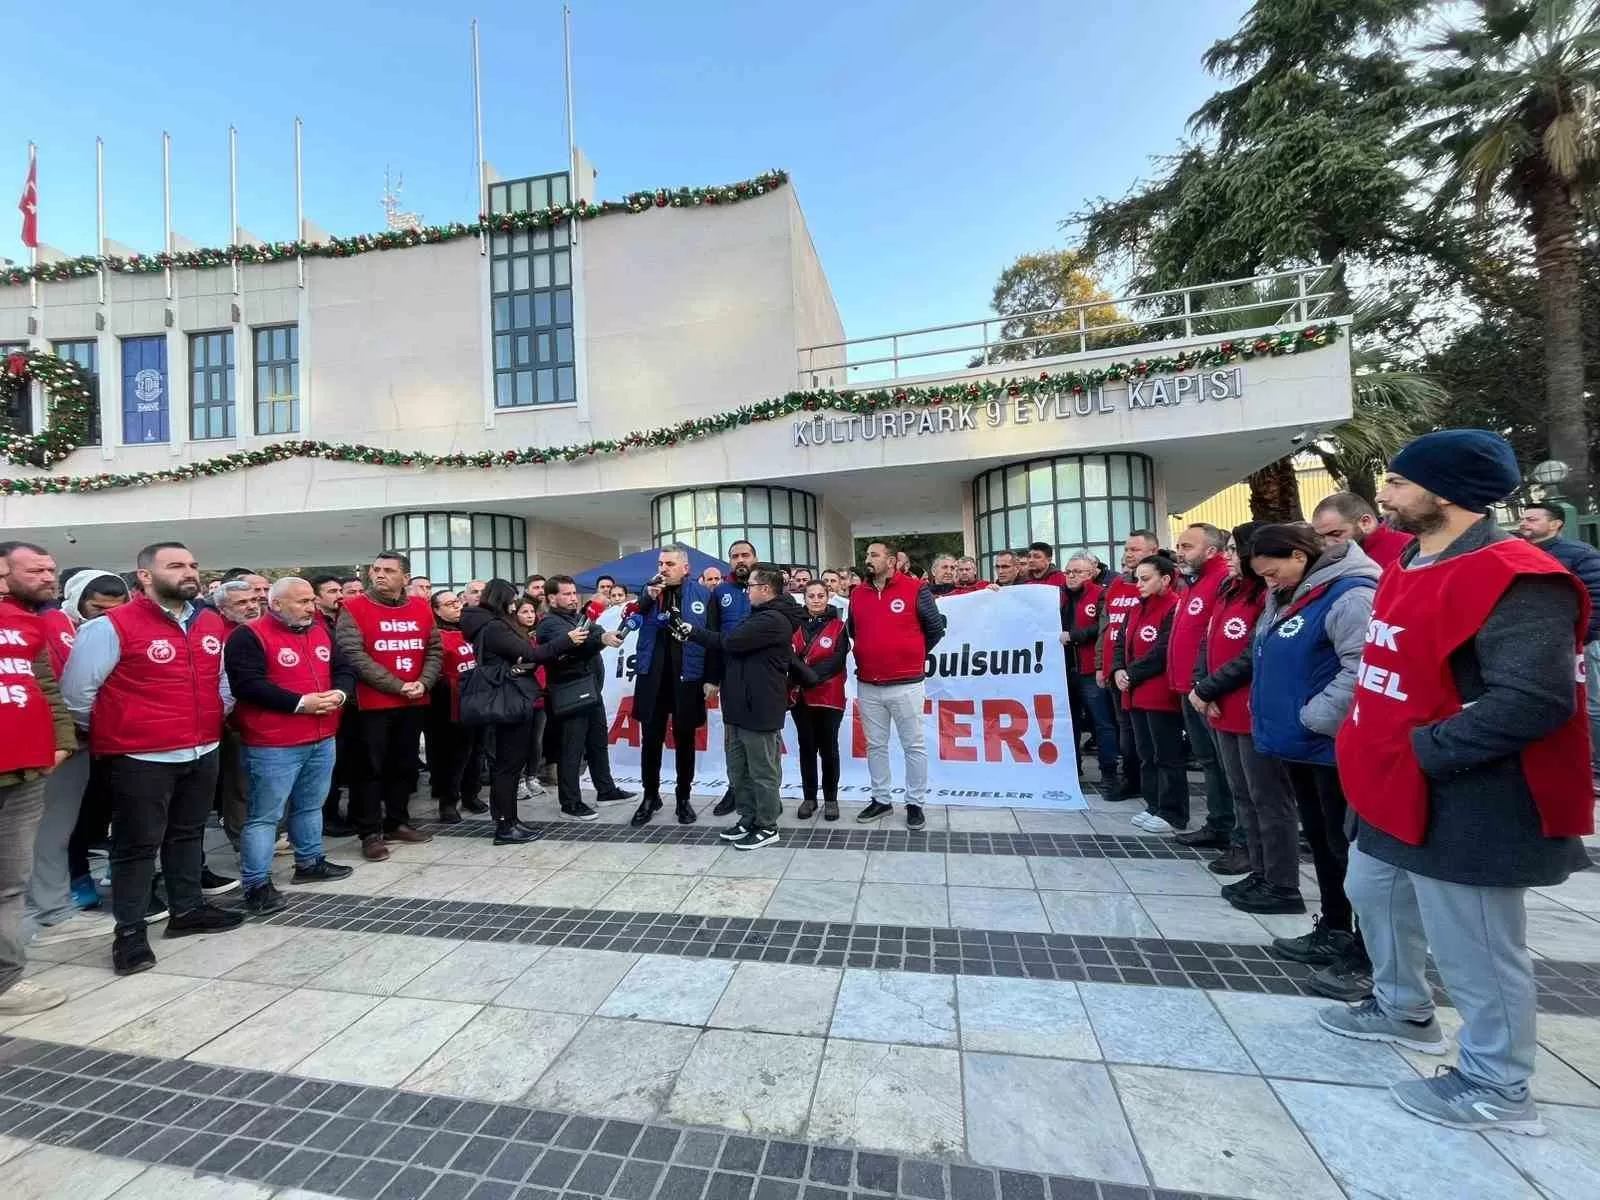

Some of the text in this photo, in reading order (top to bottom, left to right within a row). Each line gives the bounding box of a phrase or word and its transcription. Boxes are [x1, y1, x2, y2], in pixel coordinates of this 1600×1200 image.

[985, 397, 1001, 426] 9
[1127, 367, 1242, 410] KAPISI
[380, 619, 419, 632] DİSK
[374, 638, 424, 651] GENEL
[396, 656, 413, 672] İŞ
